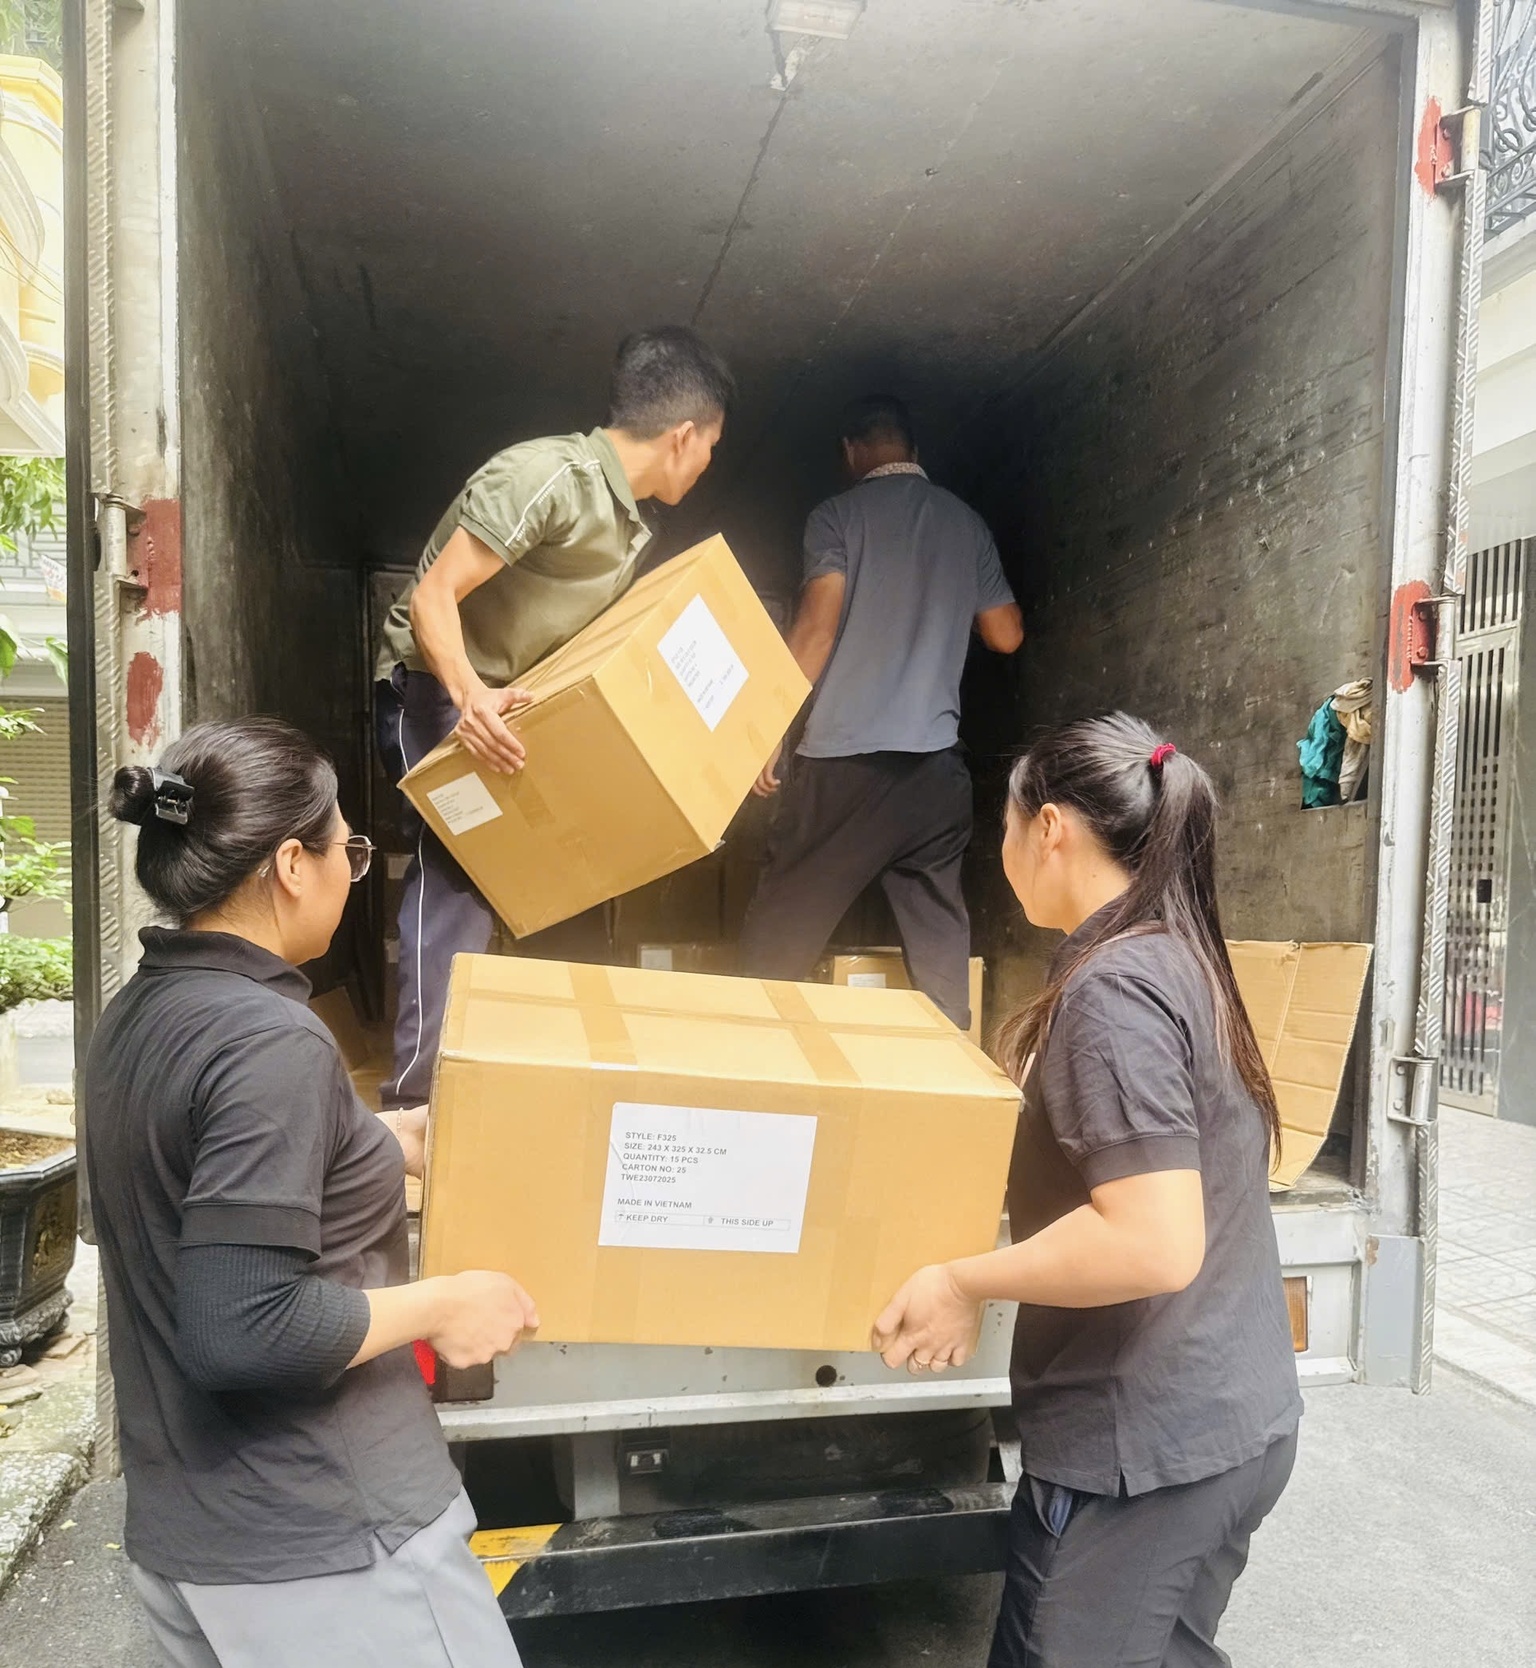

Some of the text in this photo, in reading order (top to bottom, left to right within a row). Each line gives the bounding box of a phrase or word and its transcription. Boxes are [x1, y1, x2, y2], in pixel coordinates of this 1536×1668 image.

[625, 1131, 677, 1142] STYLE: F325
[624, 1142, 646, 1151] SIZE:
[623, 1153, 668, 1163] QUANTITY:
[622, 1164, 657, 1172] CARTON
[621, 1174, 677, 1183] TWE23072025
[617, 1198, 642, 1206] MADE
[655, 1201, 693, 1209] VIETNAM
[626, 1214, 649, 1222] KEEP
[721, 1218, 740, 1226] THIS
[741, 1219, 760, 1227] SIDE
